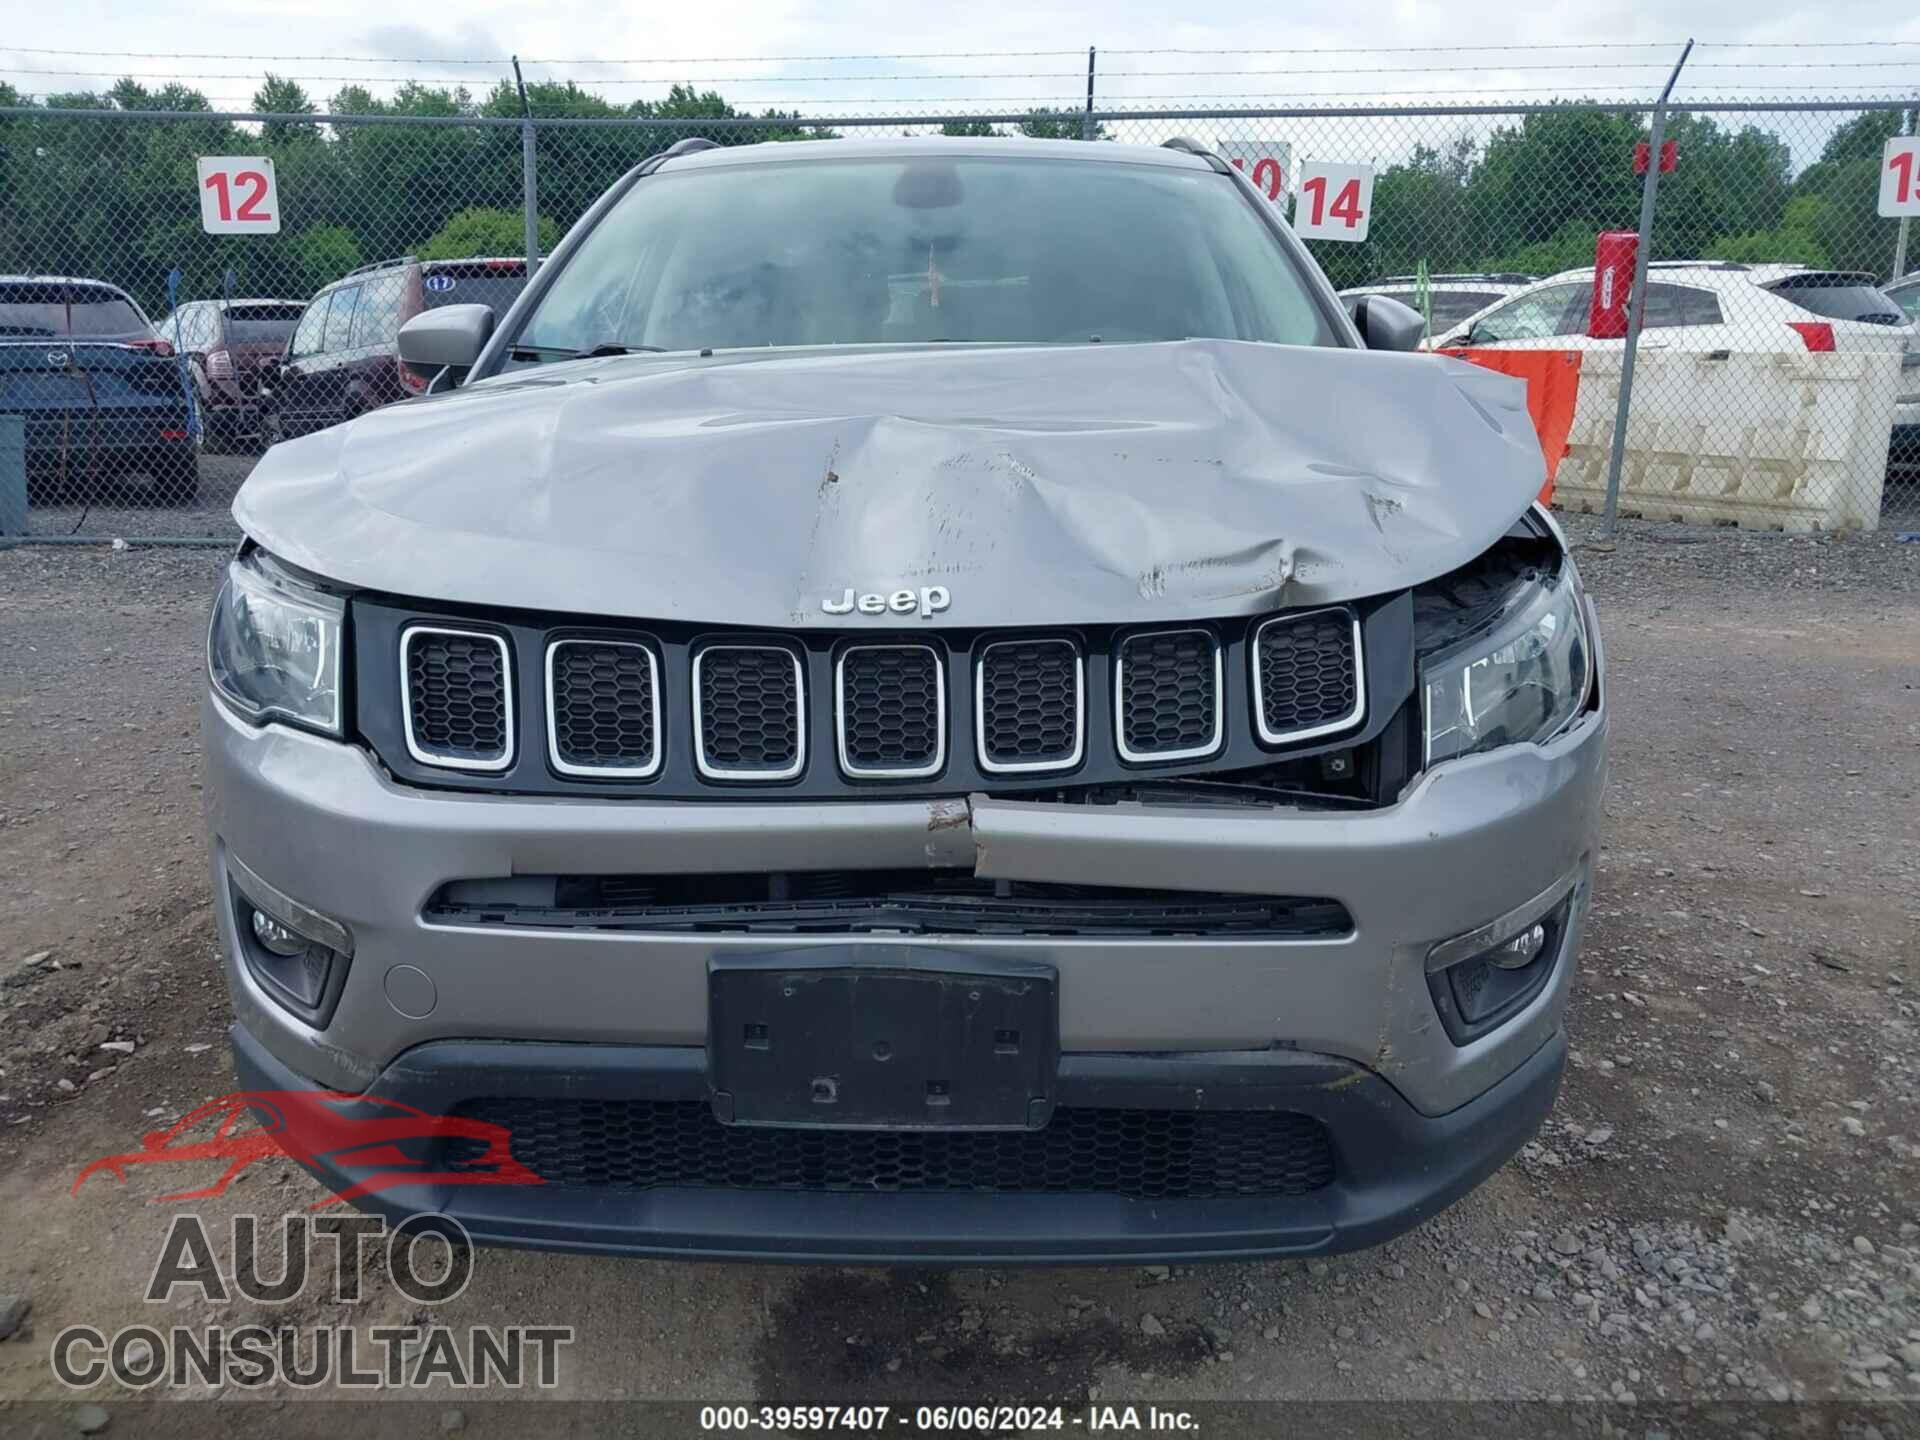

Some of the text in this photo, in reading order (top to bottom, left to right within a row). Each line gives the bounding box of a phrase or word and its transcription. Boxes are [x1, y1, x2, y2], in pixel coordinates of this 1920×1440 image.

[206, 171, 272, 221] 12
[1304, 177, 1363, 228] 14
[1889, 152, 1920, 203] 1
[821, 585, 952, 620] Jeep
